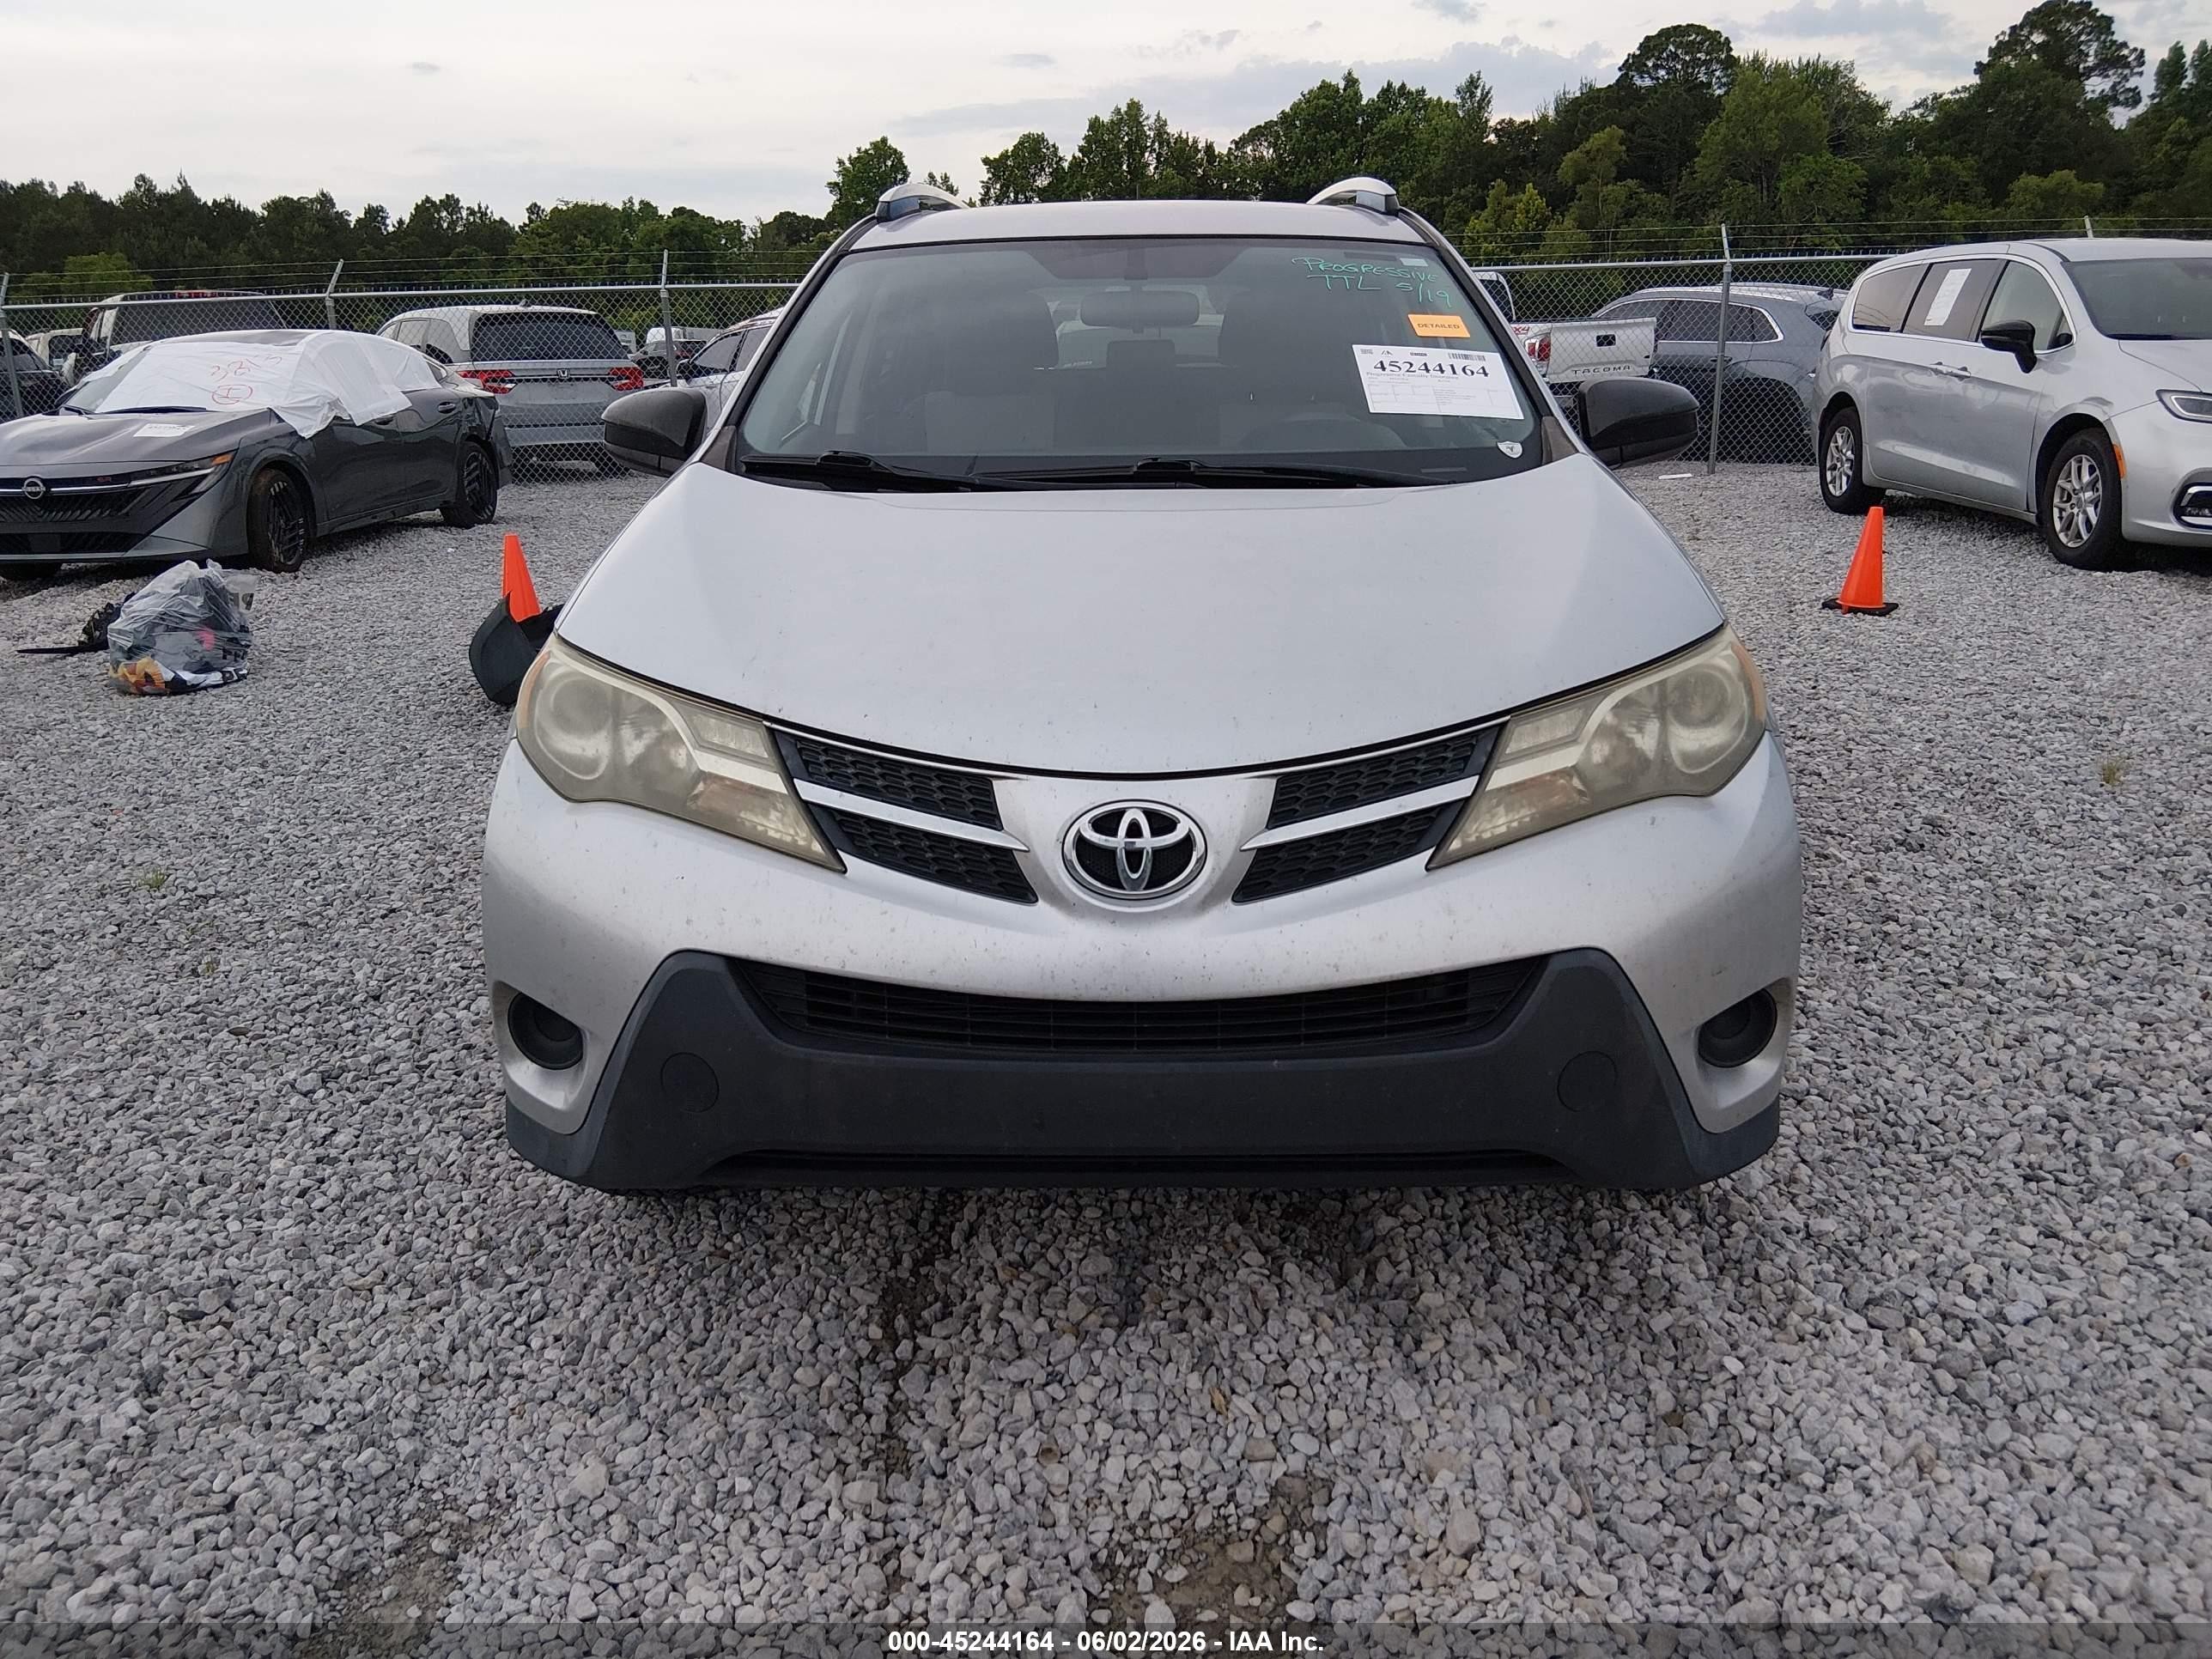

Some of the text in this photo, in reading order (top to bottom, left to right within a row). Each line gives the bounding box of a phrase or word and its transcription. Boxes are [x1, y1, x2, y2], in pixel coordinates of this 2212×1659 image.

[1291, 257, 1437, 283] PROGRESSIVE
[1307, 275, 1452, 308] TTL 5/19
[1374, 359, 1490, 378] 45244164
[1572, 366, 1632, 375] TACOMA
